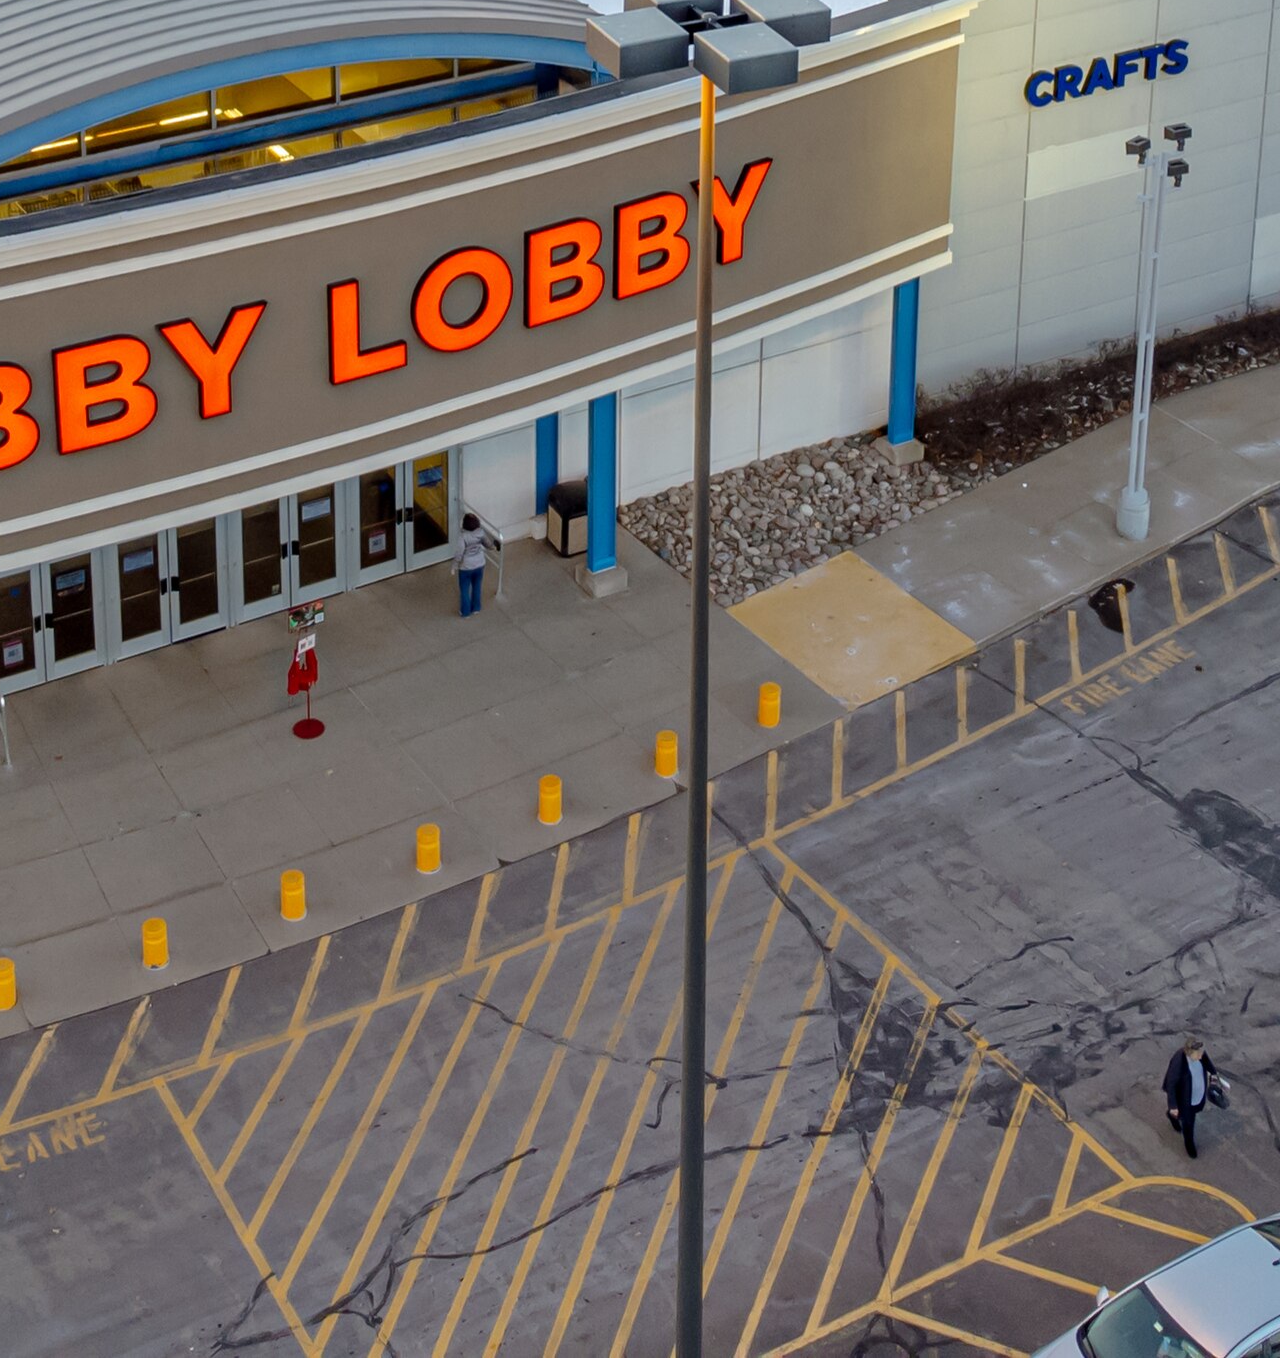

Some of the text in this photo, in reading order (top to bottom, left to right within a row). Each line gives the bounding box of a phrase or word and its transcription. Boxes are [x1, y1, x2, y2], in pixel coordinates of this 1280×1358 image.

[1025, 39, 1189, 108] CRAFTS
[327, 157, 773, 386] LOBBY
[1121, 640, 1196, 684] LANE
